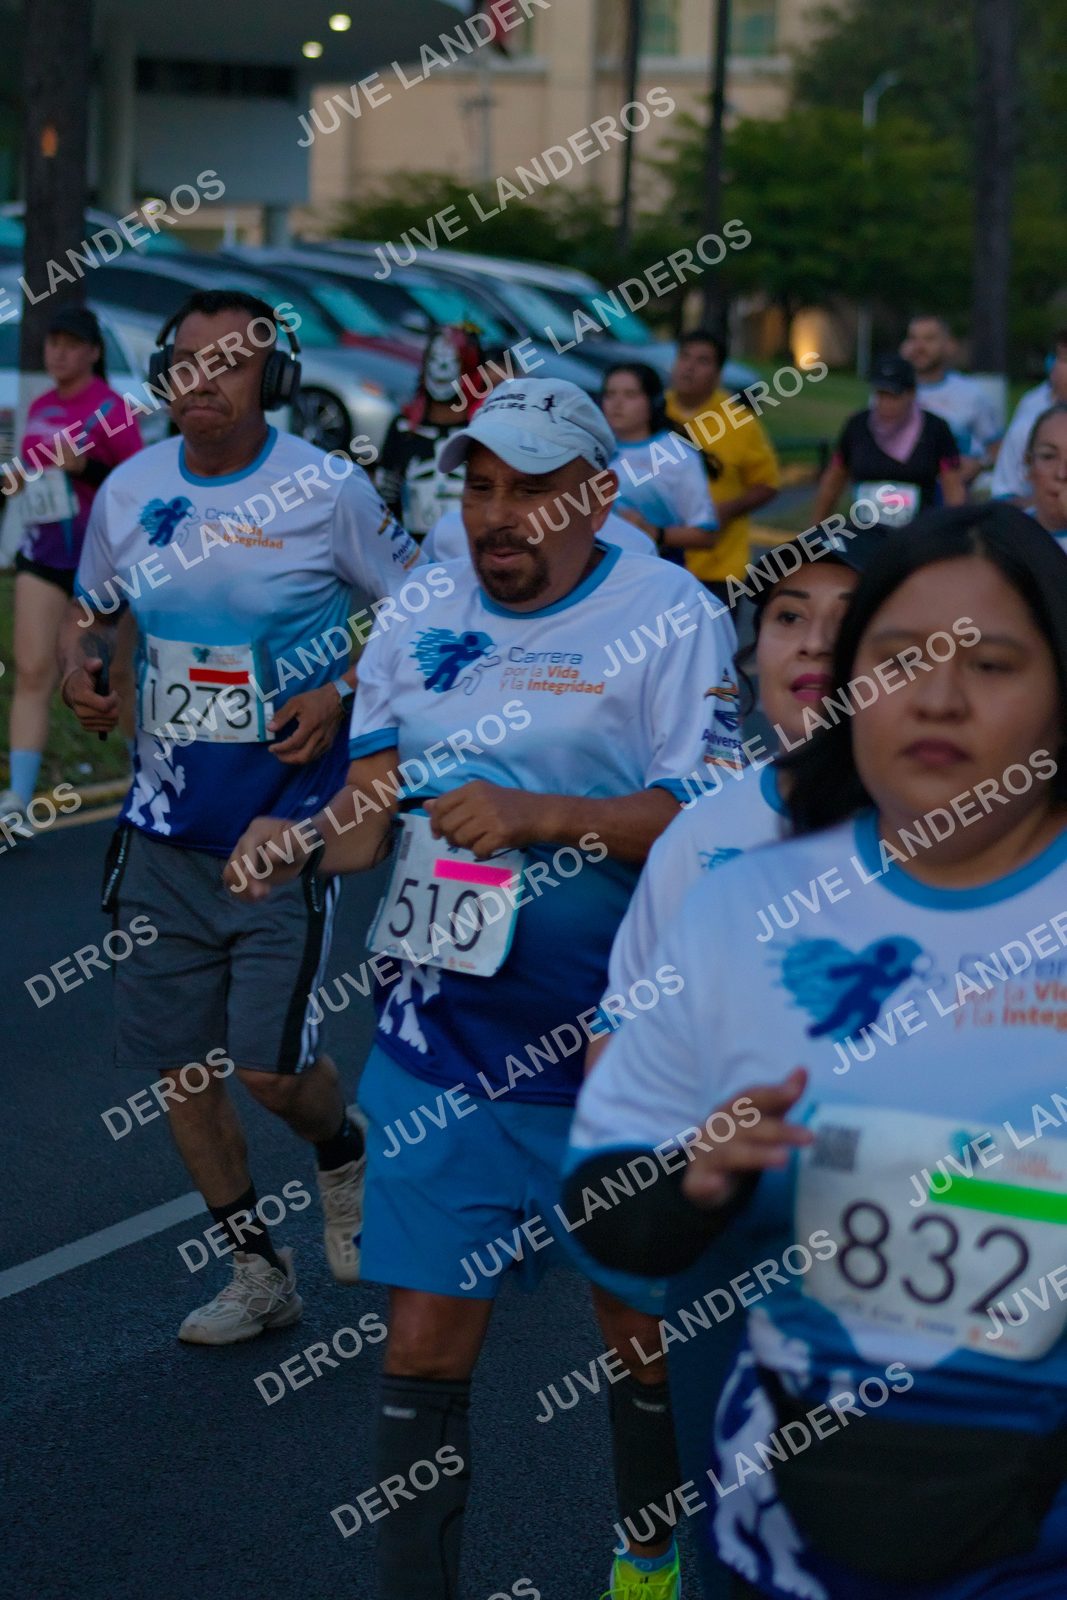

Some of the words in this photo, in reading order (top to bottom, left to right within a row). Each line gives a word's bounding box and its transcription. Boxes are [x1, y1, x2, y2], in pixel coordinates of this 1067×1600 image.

[508, 646, 583, 665] Carrera
[547, 665, 580, 679] Vida
[150, 678, 252, 730] 1273
[527, 678, 606, 695] Integridad
[388, 877, 485, 953] 510
[836, 1198, 1030, 1323] 832
